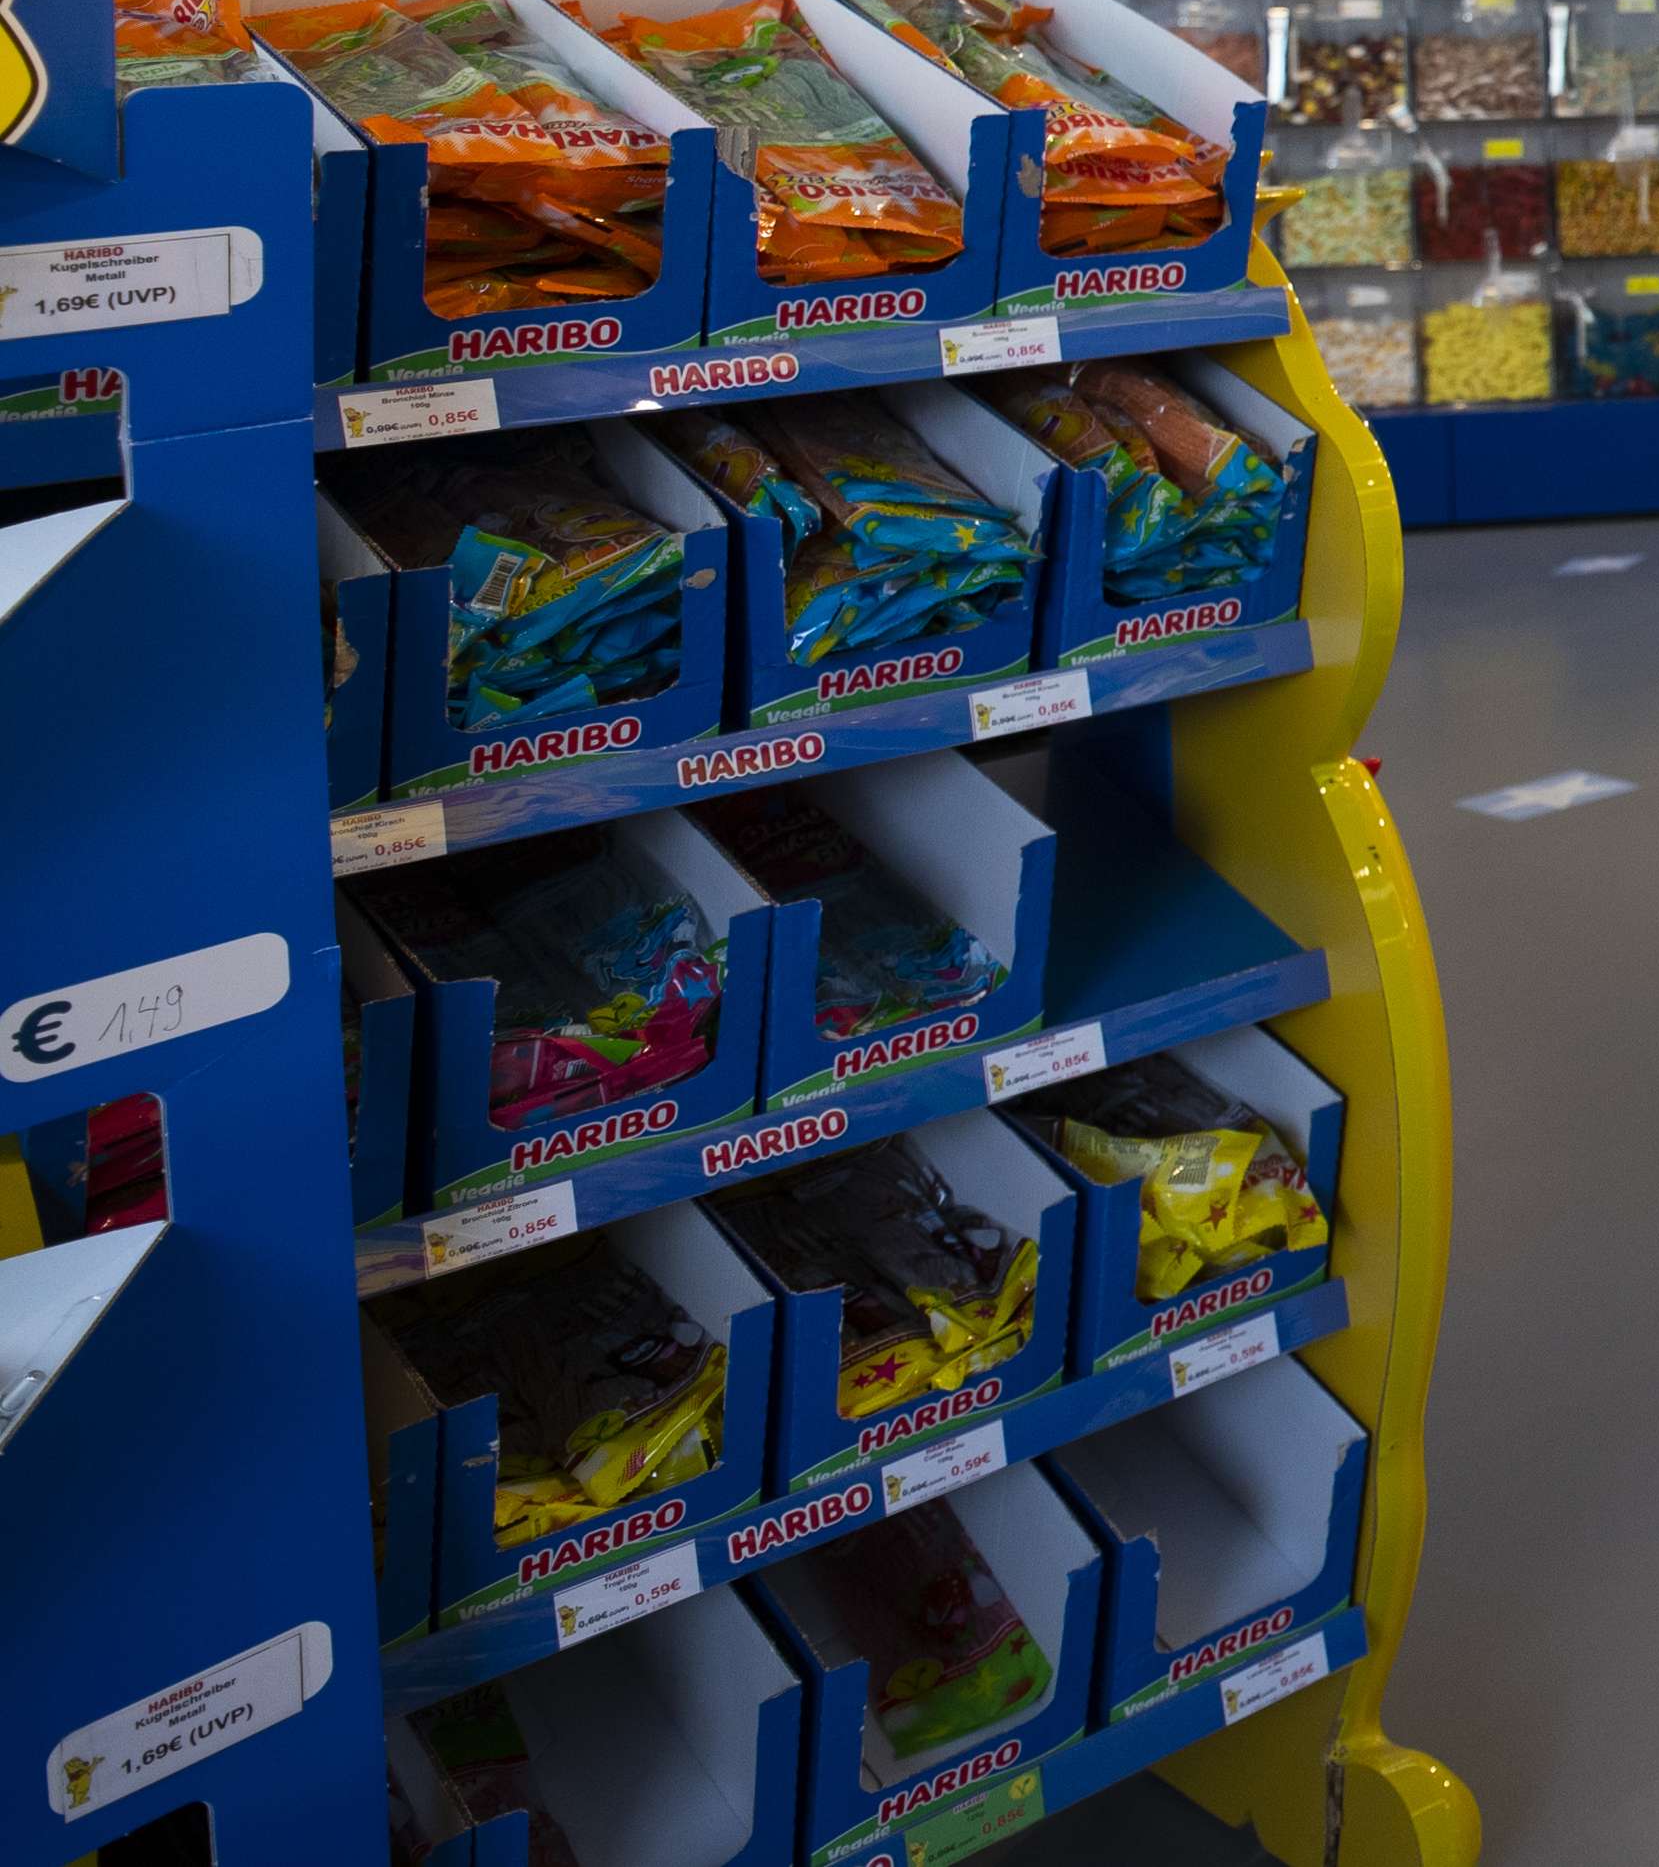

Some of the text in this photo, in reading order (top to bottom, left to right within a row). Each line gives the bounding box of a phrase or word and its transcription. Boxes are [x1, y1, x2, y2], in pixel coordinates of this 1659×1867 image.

[50, 254, 159, 273] Kugelschreiber
[64, 247, 123, 261] HARIBO
[85, 270, 126, 283] Metall
[35, 285, 176, 316] 1,69€ (UVP)
[1056, 261, 1186, 299] HARIBO
[778, 288, 926, 329] HARIBO
[450, 319, 619, 361] HARIBO
[1007, 344, 1045, 358] 0,85€
[652, 355, 798, 397] HARIBO
[428, 409, 479, 426] 0,85€
[1116, 600, 1241, 647] HARIBO
[819, 647, 963, 699] HARIBO
[1038, 699, 1076, 716] 0,85€
[471, 717, 641, 774] HARIBO
[678, 733, 823, 788] HARIBO
[375, 836, 427, 856] 0,85€
[12, 1000, 75, 1065] €
[835, 1014, 978, 1079] HARIBO
[511, 1100, 677, 1171] HARIBO
[704, 1109, 848, 1175] HARIBO
[509, 1214, 558, 1239] 0,85€
[1152, 1269, 1272, 1336] HARIBO
[859, 1379, 1002, 1452] HARIBO
[518, 1500, 686, 1584] HARIBO
[728, 1484, 872, 1562] HARIBO
[635, 1578, 681, 1605] 0,59€
[1171, 1607, 1294, 1682] HARIBO
[134, 1675, 238, 1730] Kugelschreiber
[168, 1704, 207, 1730] Metall
[119, 1702, 255, 1777] 1,69€ (UVP)
[879, 1741, 1022, 1824] HARIBO
